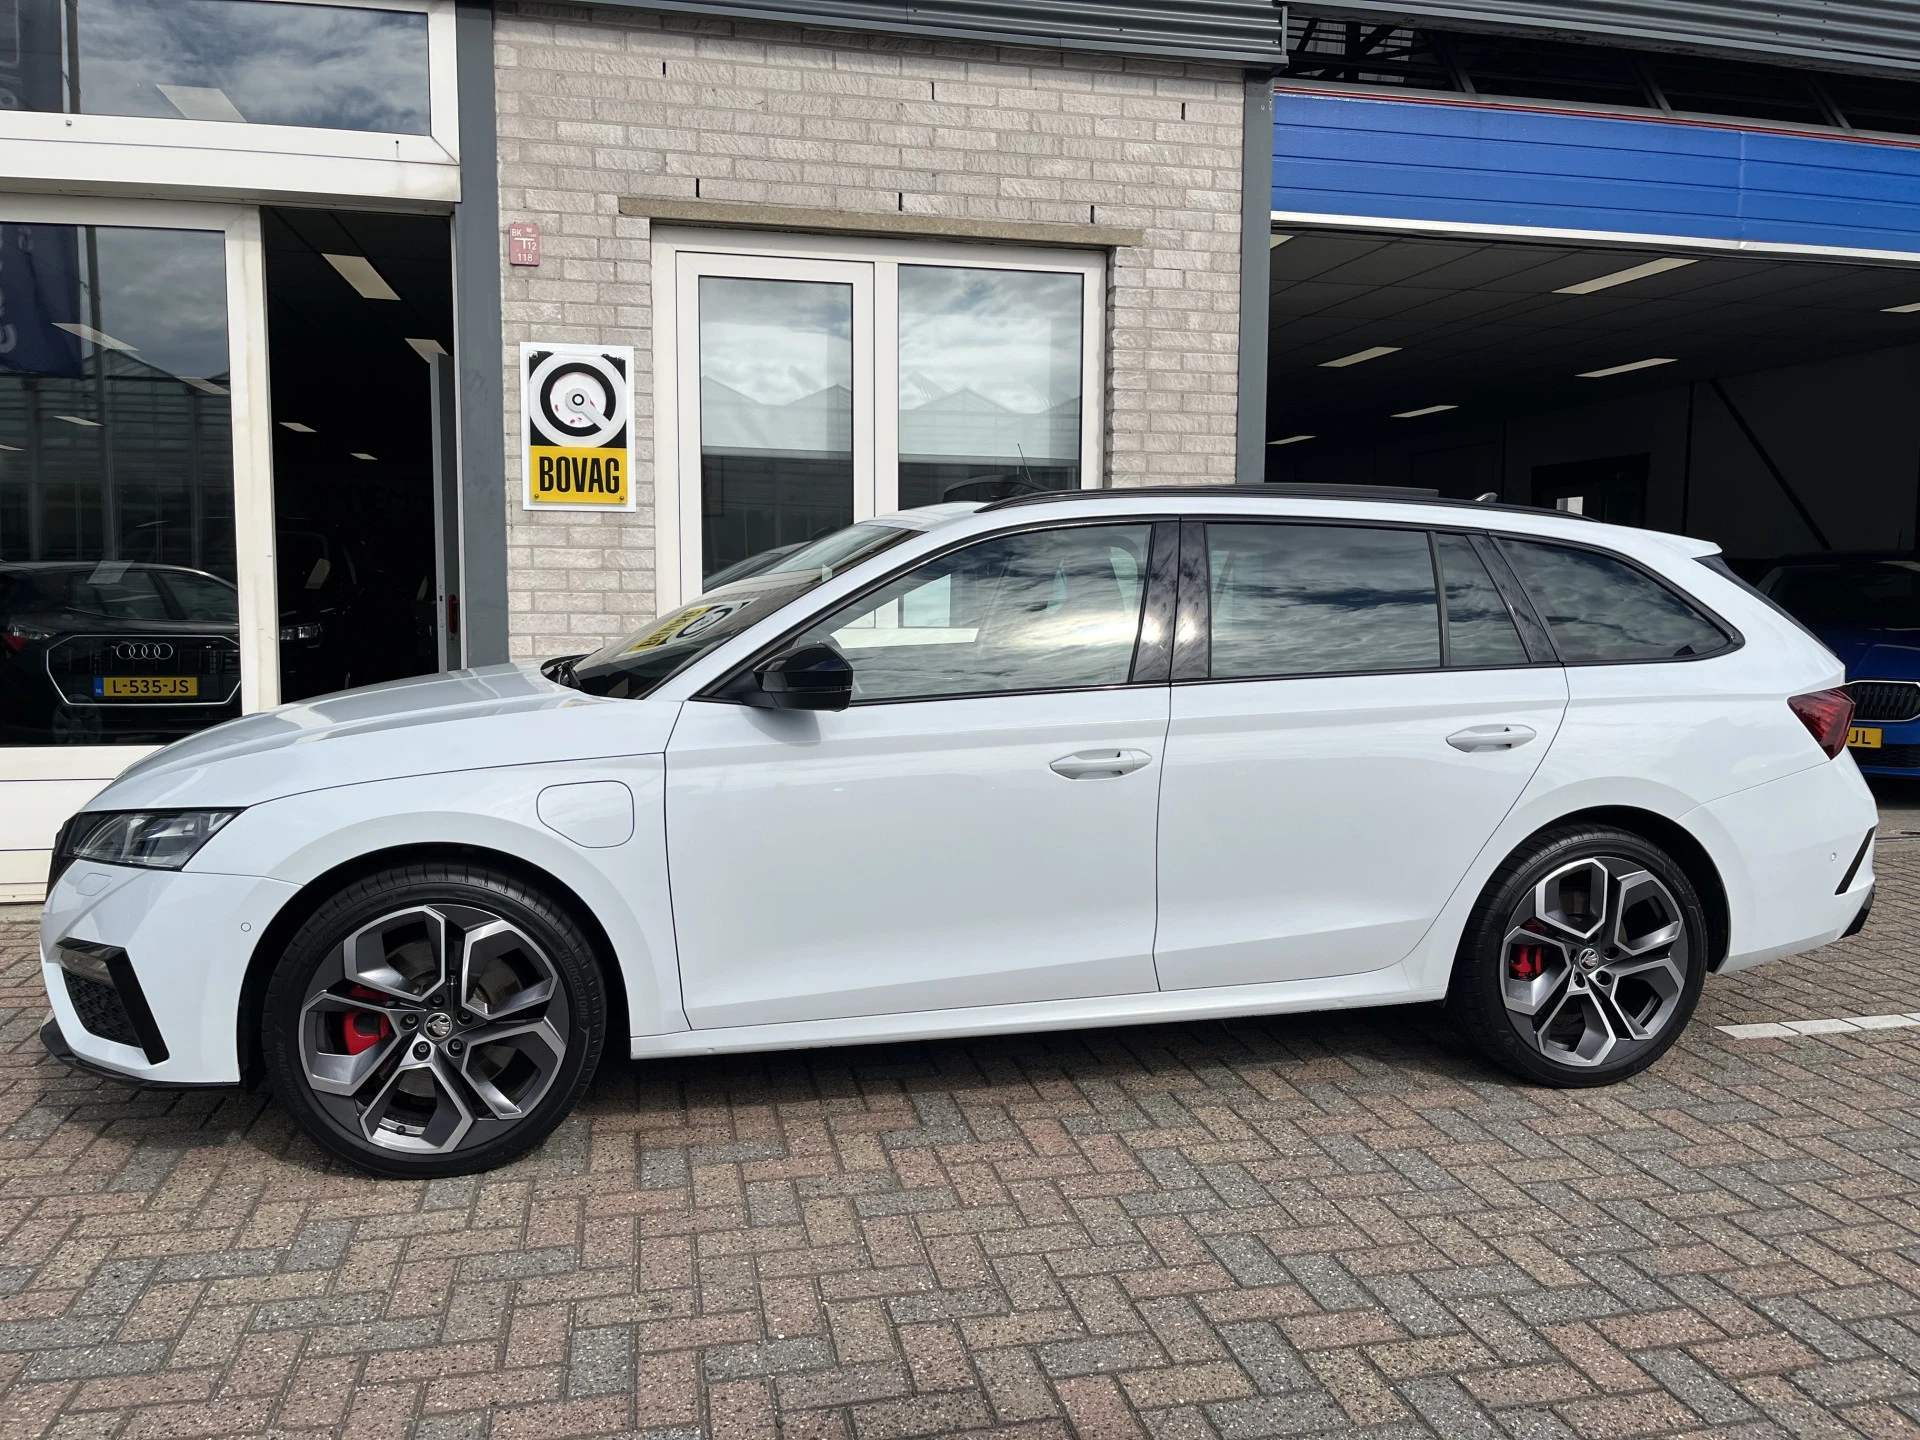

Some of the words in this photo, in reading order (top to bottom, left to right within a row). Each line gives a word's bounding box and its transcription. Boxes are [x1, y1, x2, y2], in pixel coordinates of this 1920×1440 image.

[511, 228, 522, 237] BK
[517, 253, 533, 262] 118
[539, 456, 620, 494] BOVAG
[112, 679, 189, 694] L-535-JS
